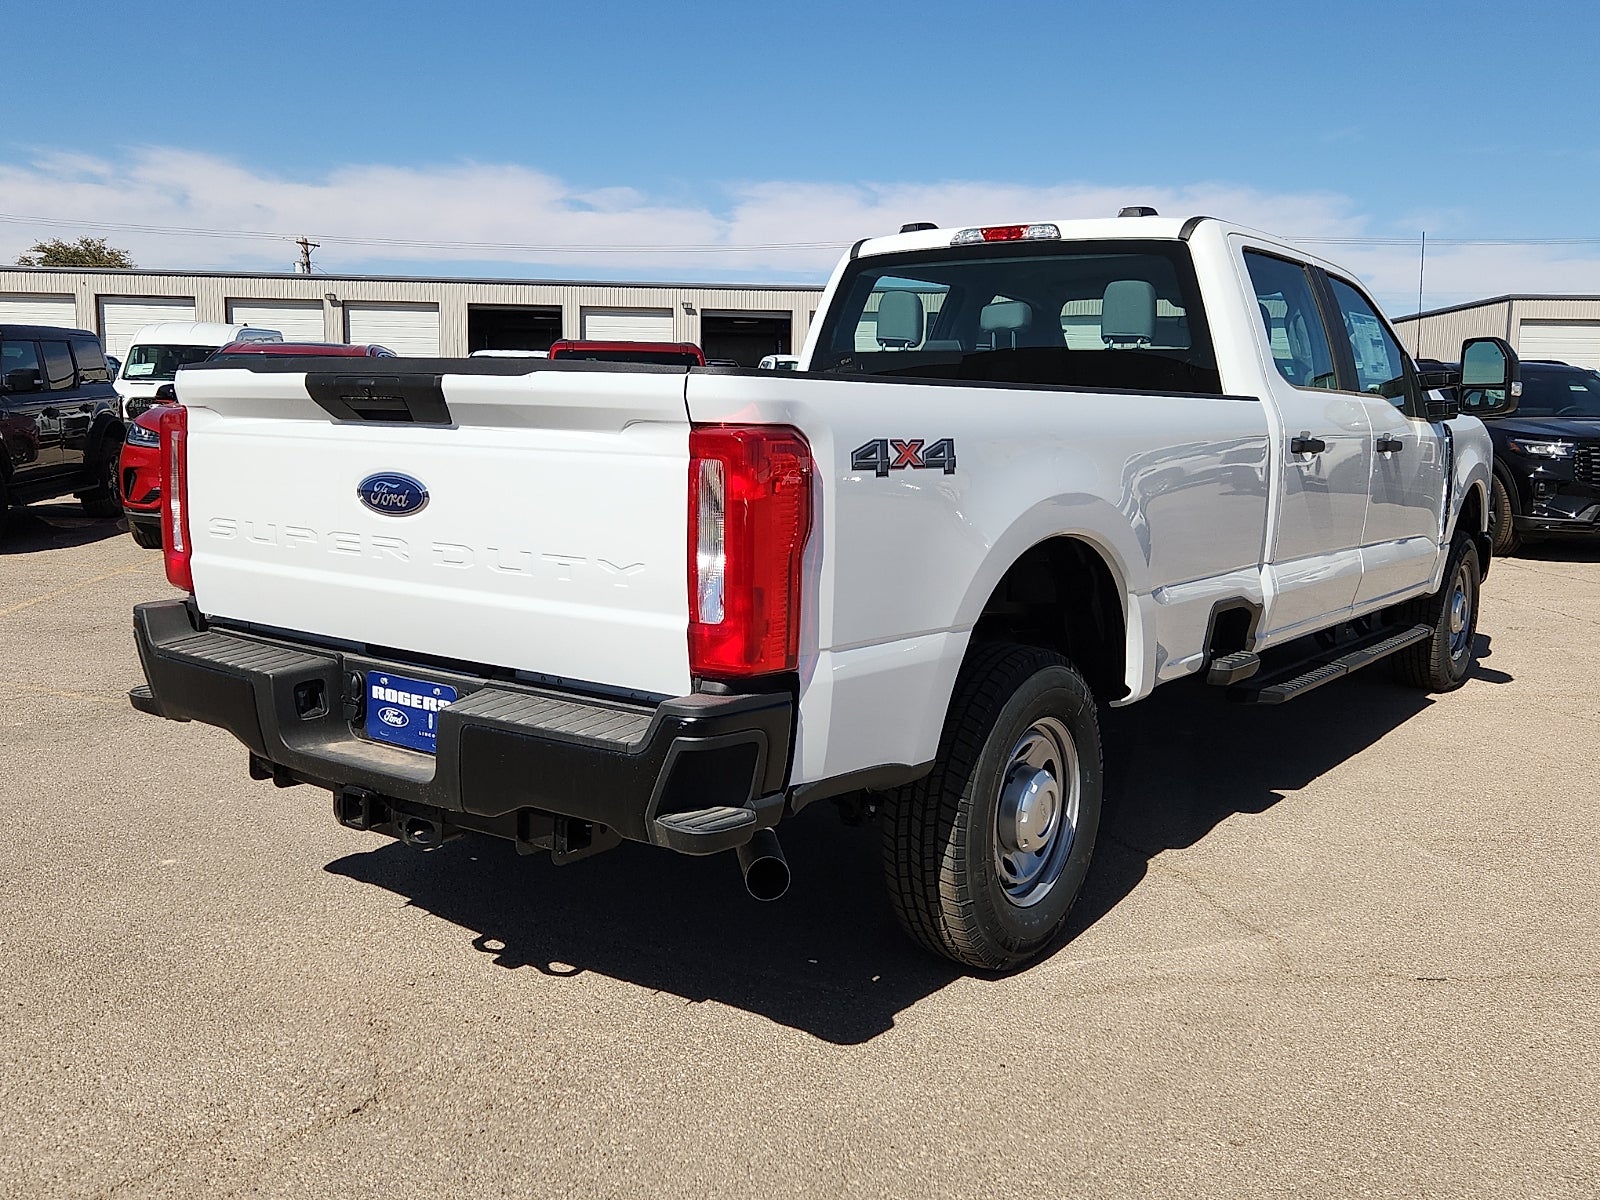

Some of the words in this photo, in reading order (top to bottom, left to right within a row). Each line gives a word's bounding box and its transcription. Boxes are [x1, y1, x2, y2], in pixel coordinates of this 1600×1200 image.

[370, 481, 410, 507] Ford
[208, 516, 411, 563] SUPER
[431, 541, 646, 588] DUTY
[383, 709, 404, 725] Ford
